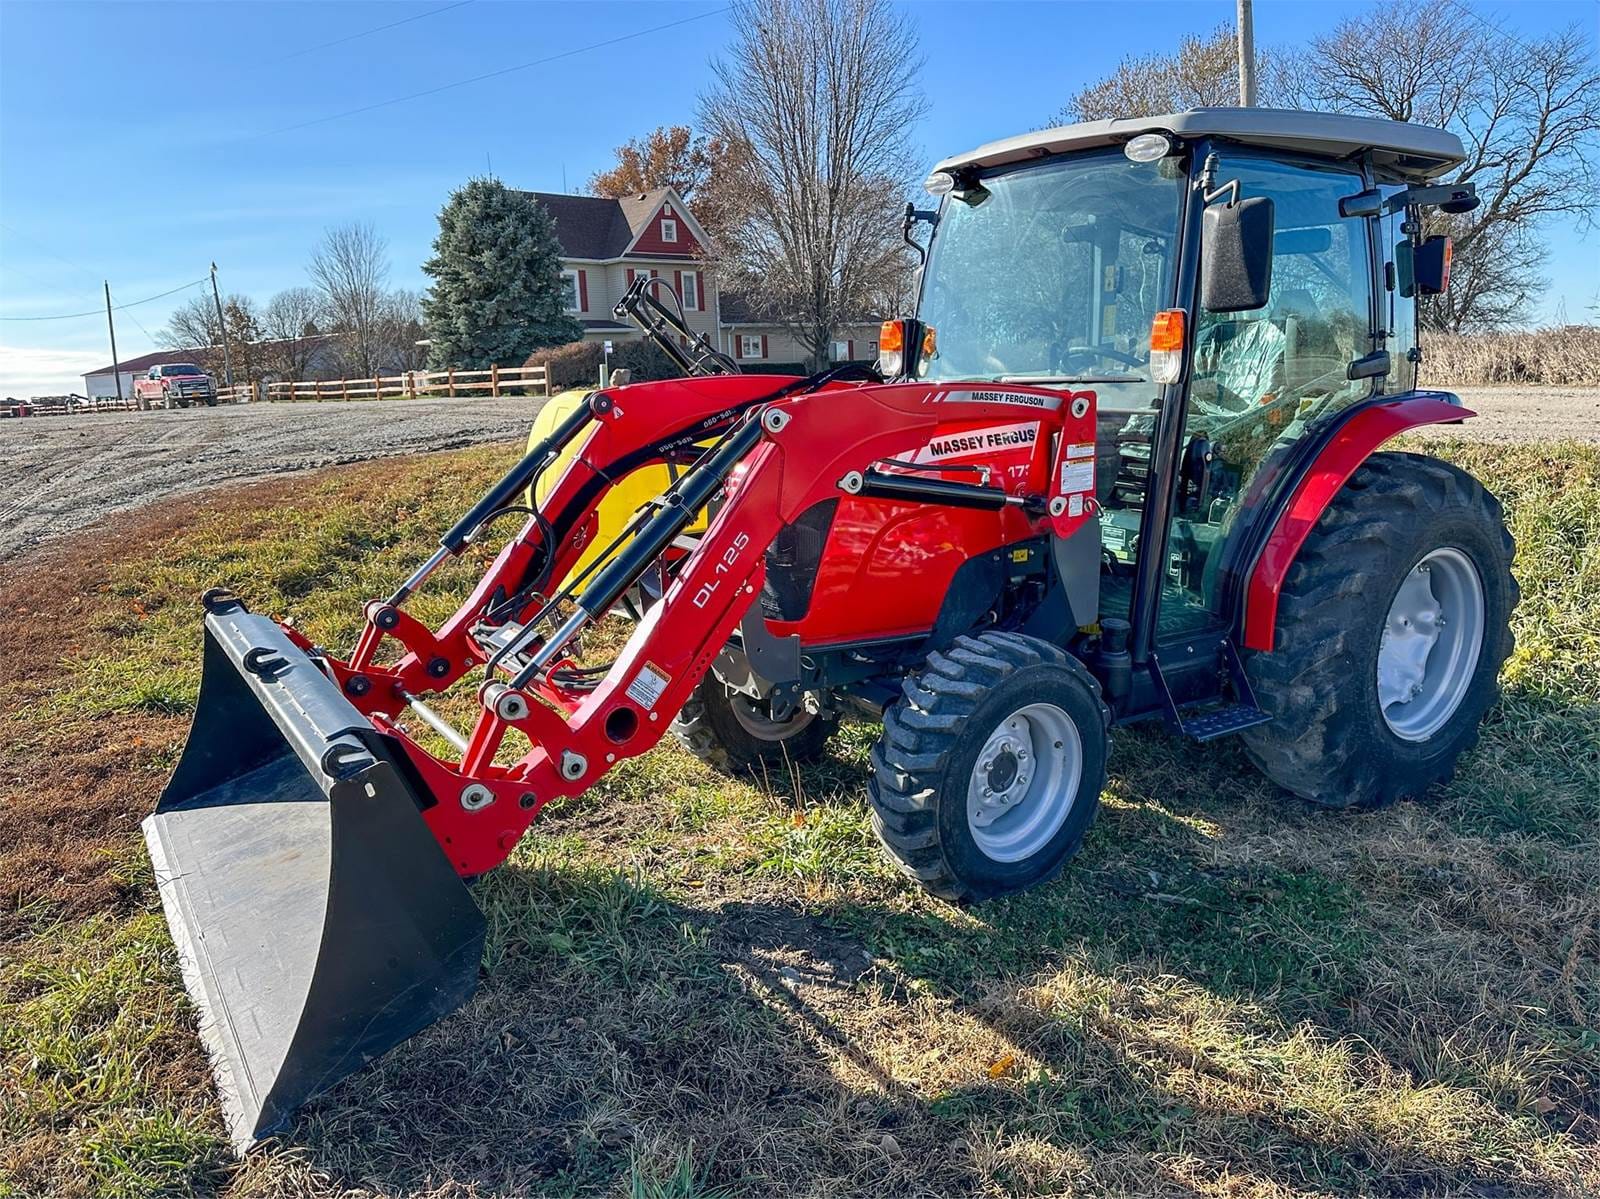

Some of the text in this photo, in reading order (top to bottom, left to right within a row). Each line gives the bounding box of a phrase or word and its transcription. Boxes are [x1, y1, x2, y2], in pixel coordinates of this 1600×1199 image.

[972, 392, 1044, 406] MASSEY FERGUSON
[929, 429, 1036, 456] MASSEY FERGUS
